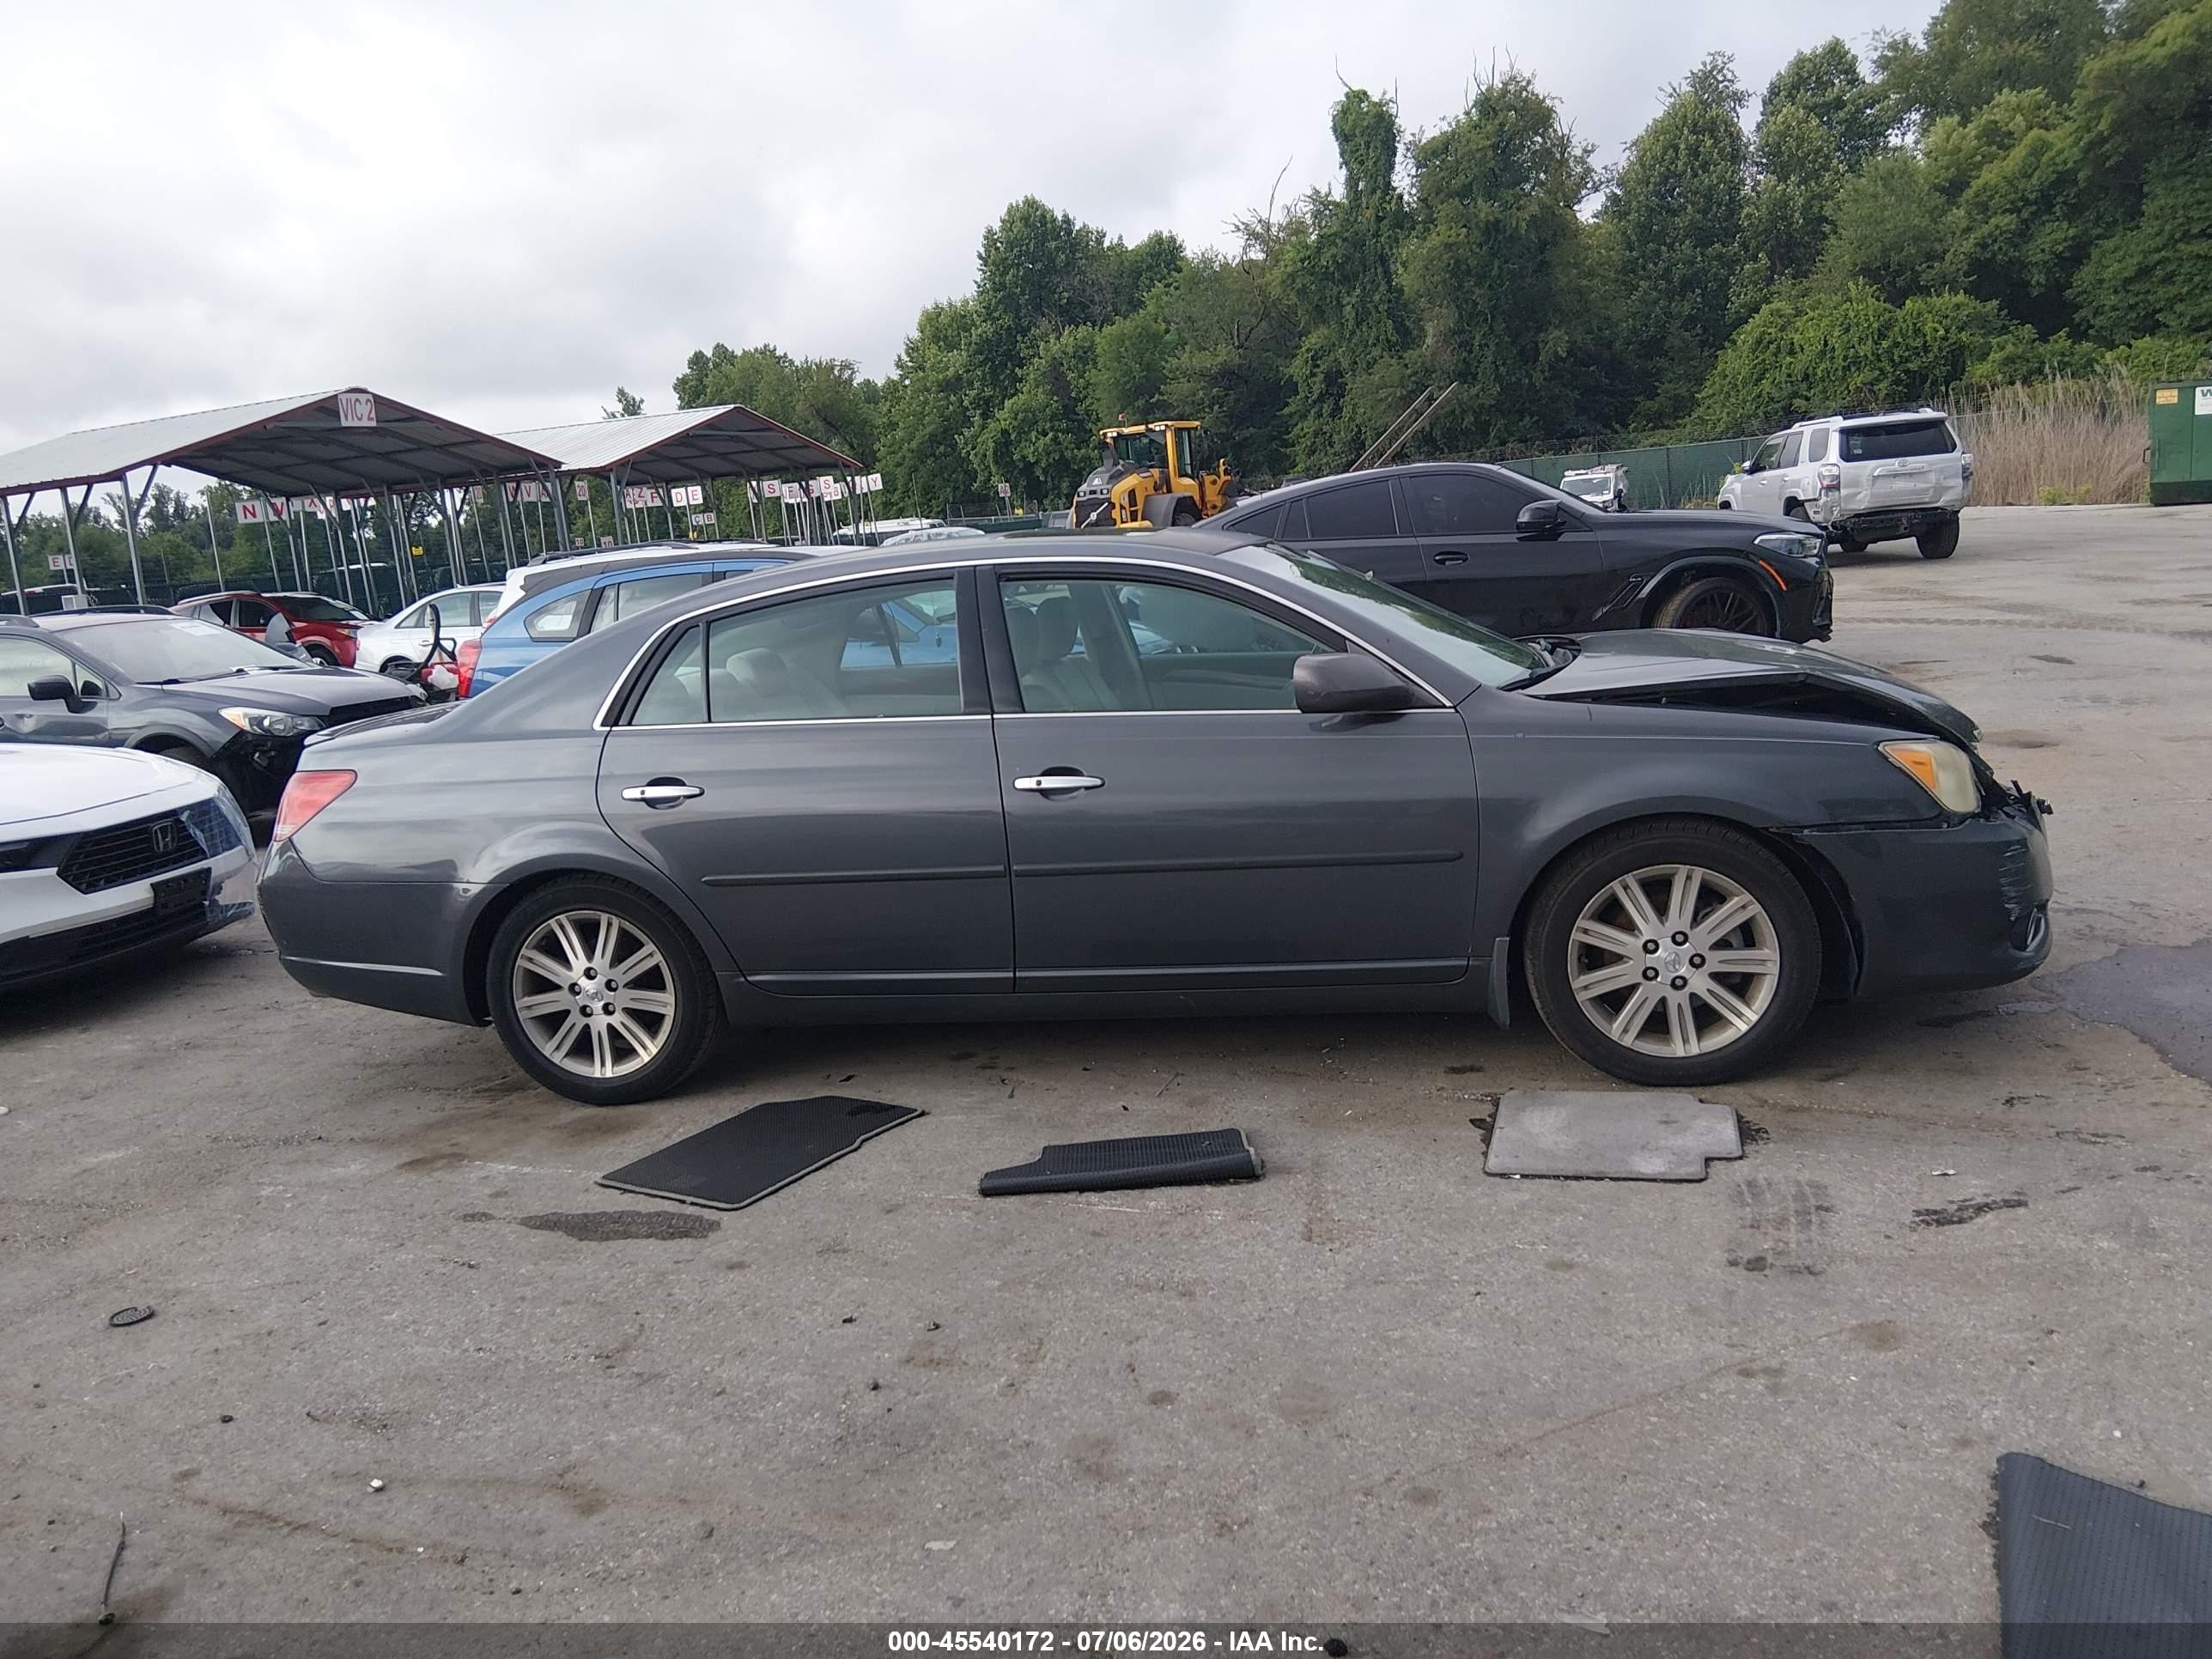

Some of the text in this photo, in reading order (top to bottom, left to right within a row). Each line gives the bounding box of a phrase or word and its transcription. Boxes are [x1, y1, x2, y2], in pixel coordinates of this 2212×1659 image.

[340, 398, 375, 422] VIC 2
[823, 479, 831, 489] S
[871, 477, 878, 488] Y
[577, 485, 586, 497] 20
[691, 489, 700, 501] E
[767, 483, 776, 495] S
[650, 492, 659, 504] F
[675, 492, 683, 503] D
[241, 504, 258, 520] N
[52, 557, 60, 568] E
